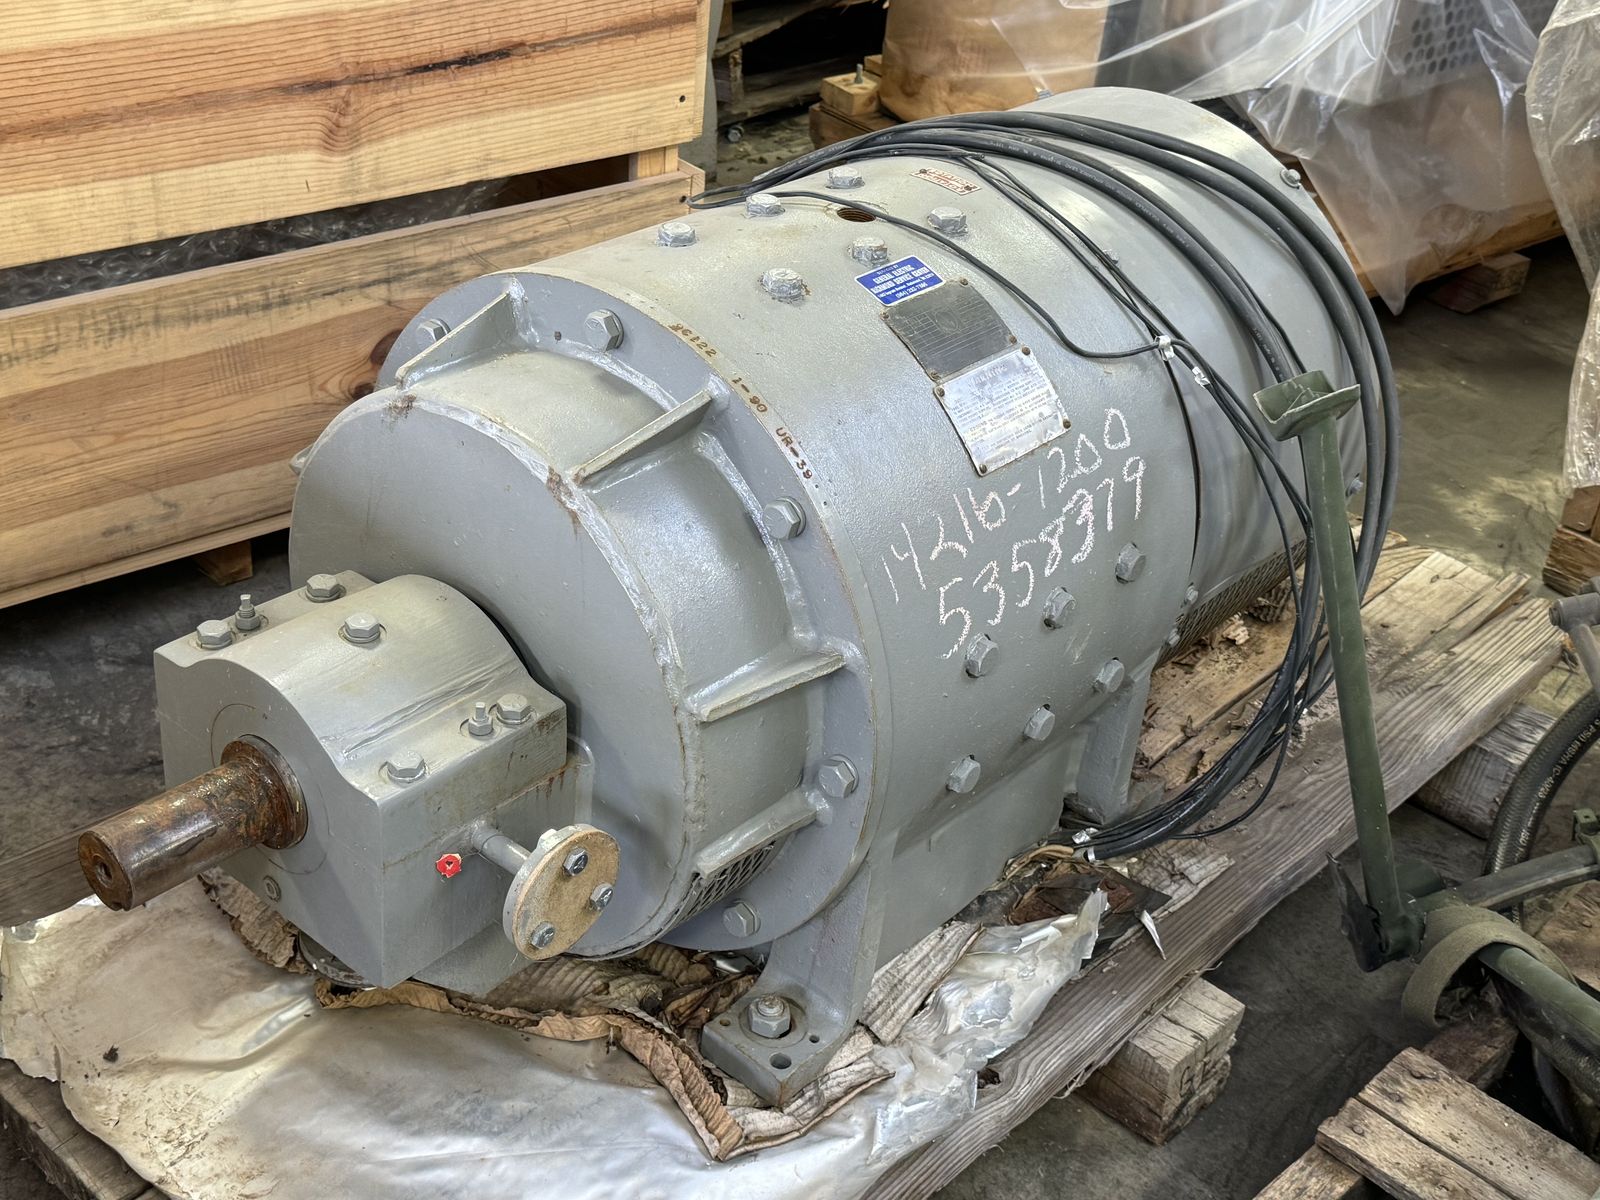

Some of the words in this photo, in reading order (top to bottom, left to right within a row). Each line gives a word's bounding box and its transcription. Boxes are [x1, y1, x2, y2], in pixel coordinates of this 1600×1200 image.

[872, 273, 895, 285] GENERAL
[891, 264, 915, 277] ELECTRIC
[893, 273, 914, 285] SERVICE
[731, 376, 769, 414] 1-90
[775, 427, 813, 480] UR-39
[881, 407, 1131, 605] 14216-1200
[936, 455, 1146, 660] 5358379
